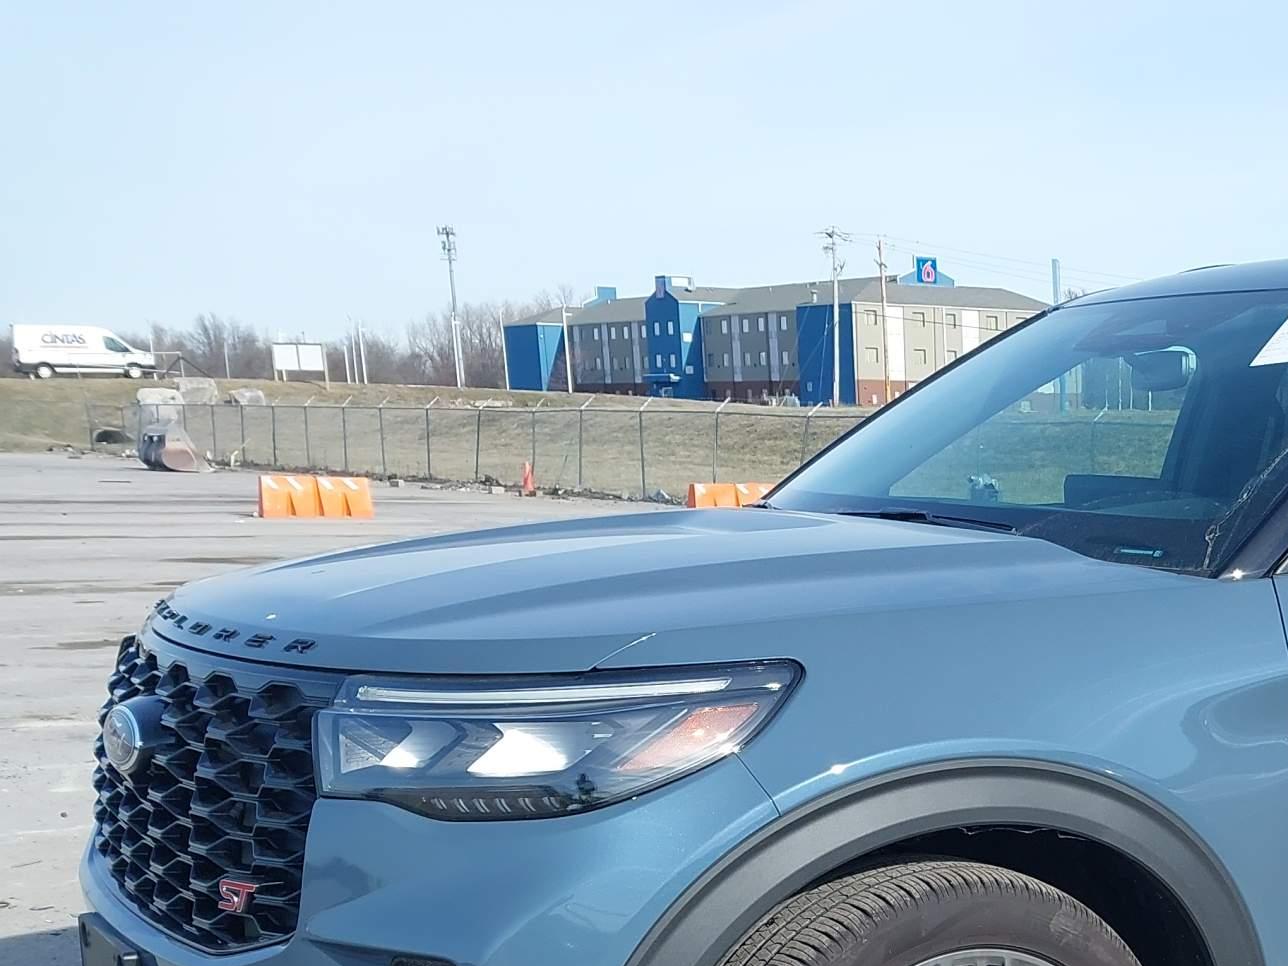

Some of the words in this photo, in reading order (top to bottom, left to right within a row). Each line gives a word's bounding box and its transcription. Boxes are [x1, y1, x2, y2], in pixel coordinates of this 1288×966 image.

[921, 260, 936, 284] 6
[41, 331, 86, 344] CINTAS
[217, 879, 257, 913] ST
